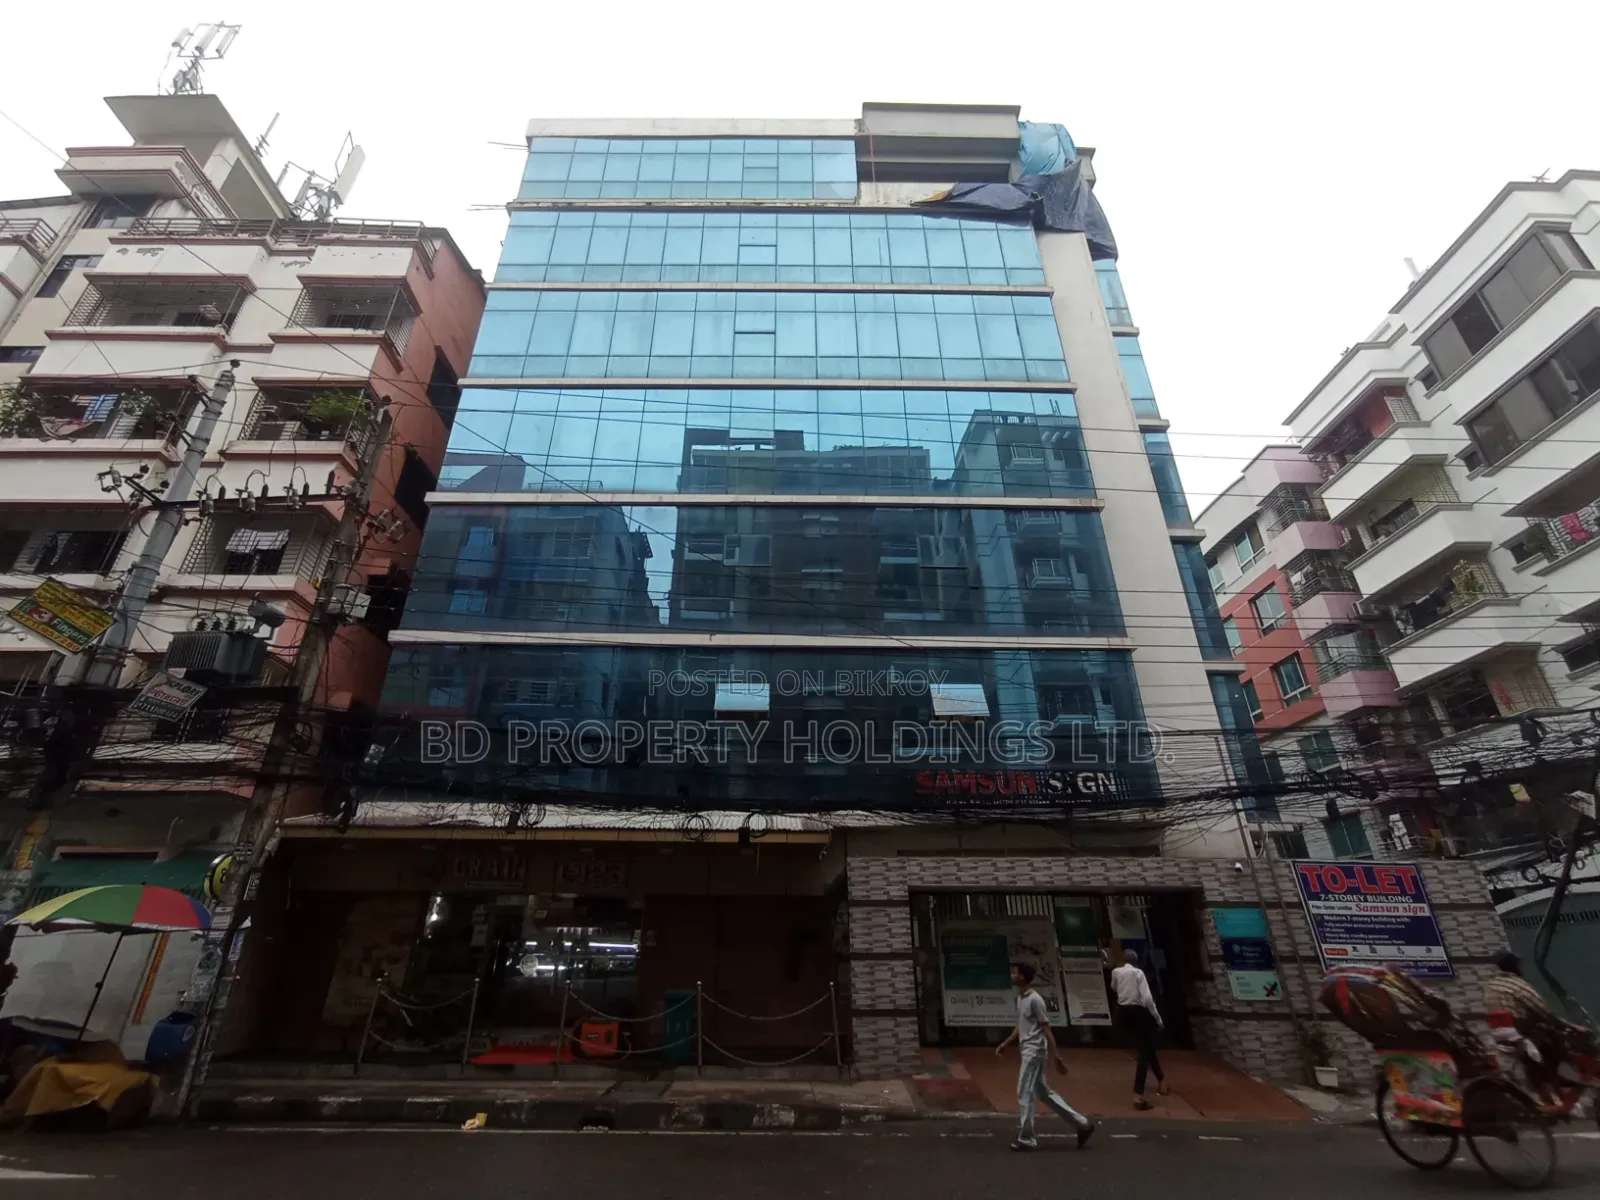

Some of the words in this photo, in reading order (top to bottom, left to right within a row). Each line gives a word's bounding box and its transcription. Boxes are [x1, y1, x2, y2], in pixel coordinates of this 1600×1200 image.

[51, 618, 89, 643] Fingers
[916, 770, 1038, 795] SAMSUN
[1300, 865, 1416, 894] TO-LET
[1319, 893, 1365, 902] 7-STOREY
[1367, 894, 1413, 903] BUILDING
[1355, 903, 1400, 913] Samsun
[1402, 904, 1426, 915] sign
[1371, 916, 1396, 924] building
